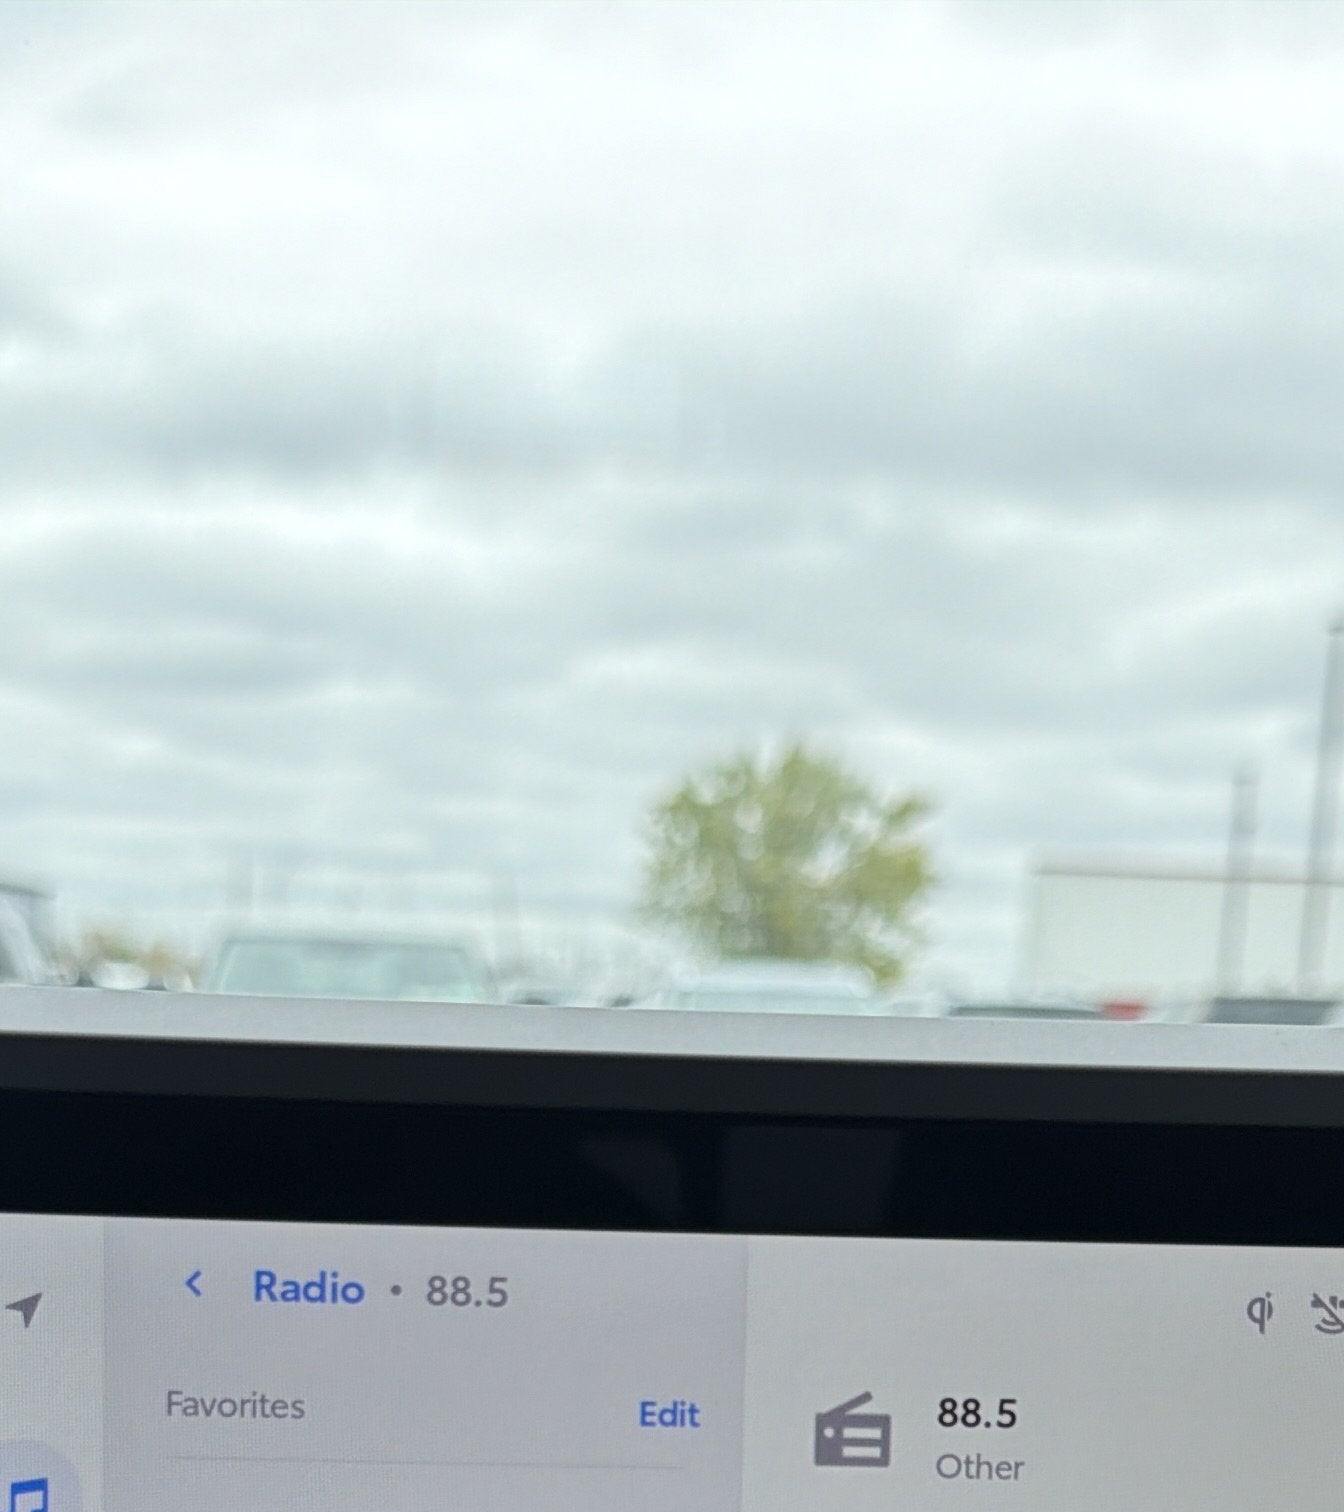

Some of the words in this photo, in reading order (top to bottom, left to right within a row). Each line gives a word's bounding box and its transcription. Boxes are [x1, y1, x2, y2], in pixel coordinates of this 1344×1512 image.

[254, 1271, 365, 1305] Radio
[425, 1276, 510, 1307] 88.5
[165, 1390, 306, 1419] Favorites
[639, 1401, 701, 1429] Edit
[937, 1399, 1018, 1429] 88.5
[936, 1453, 1025, 1481] Other
